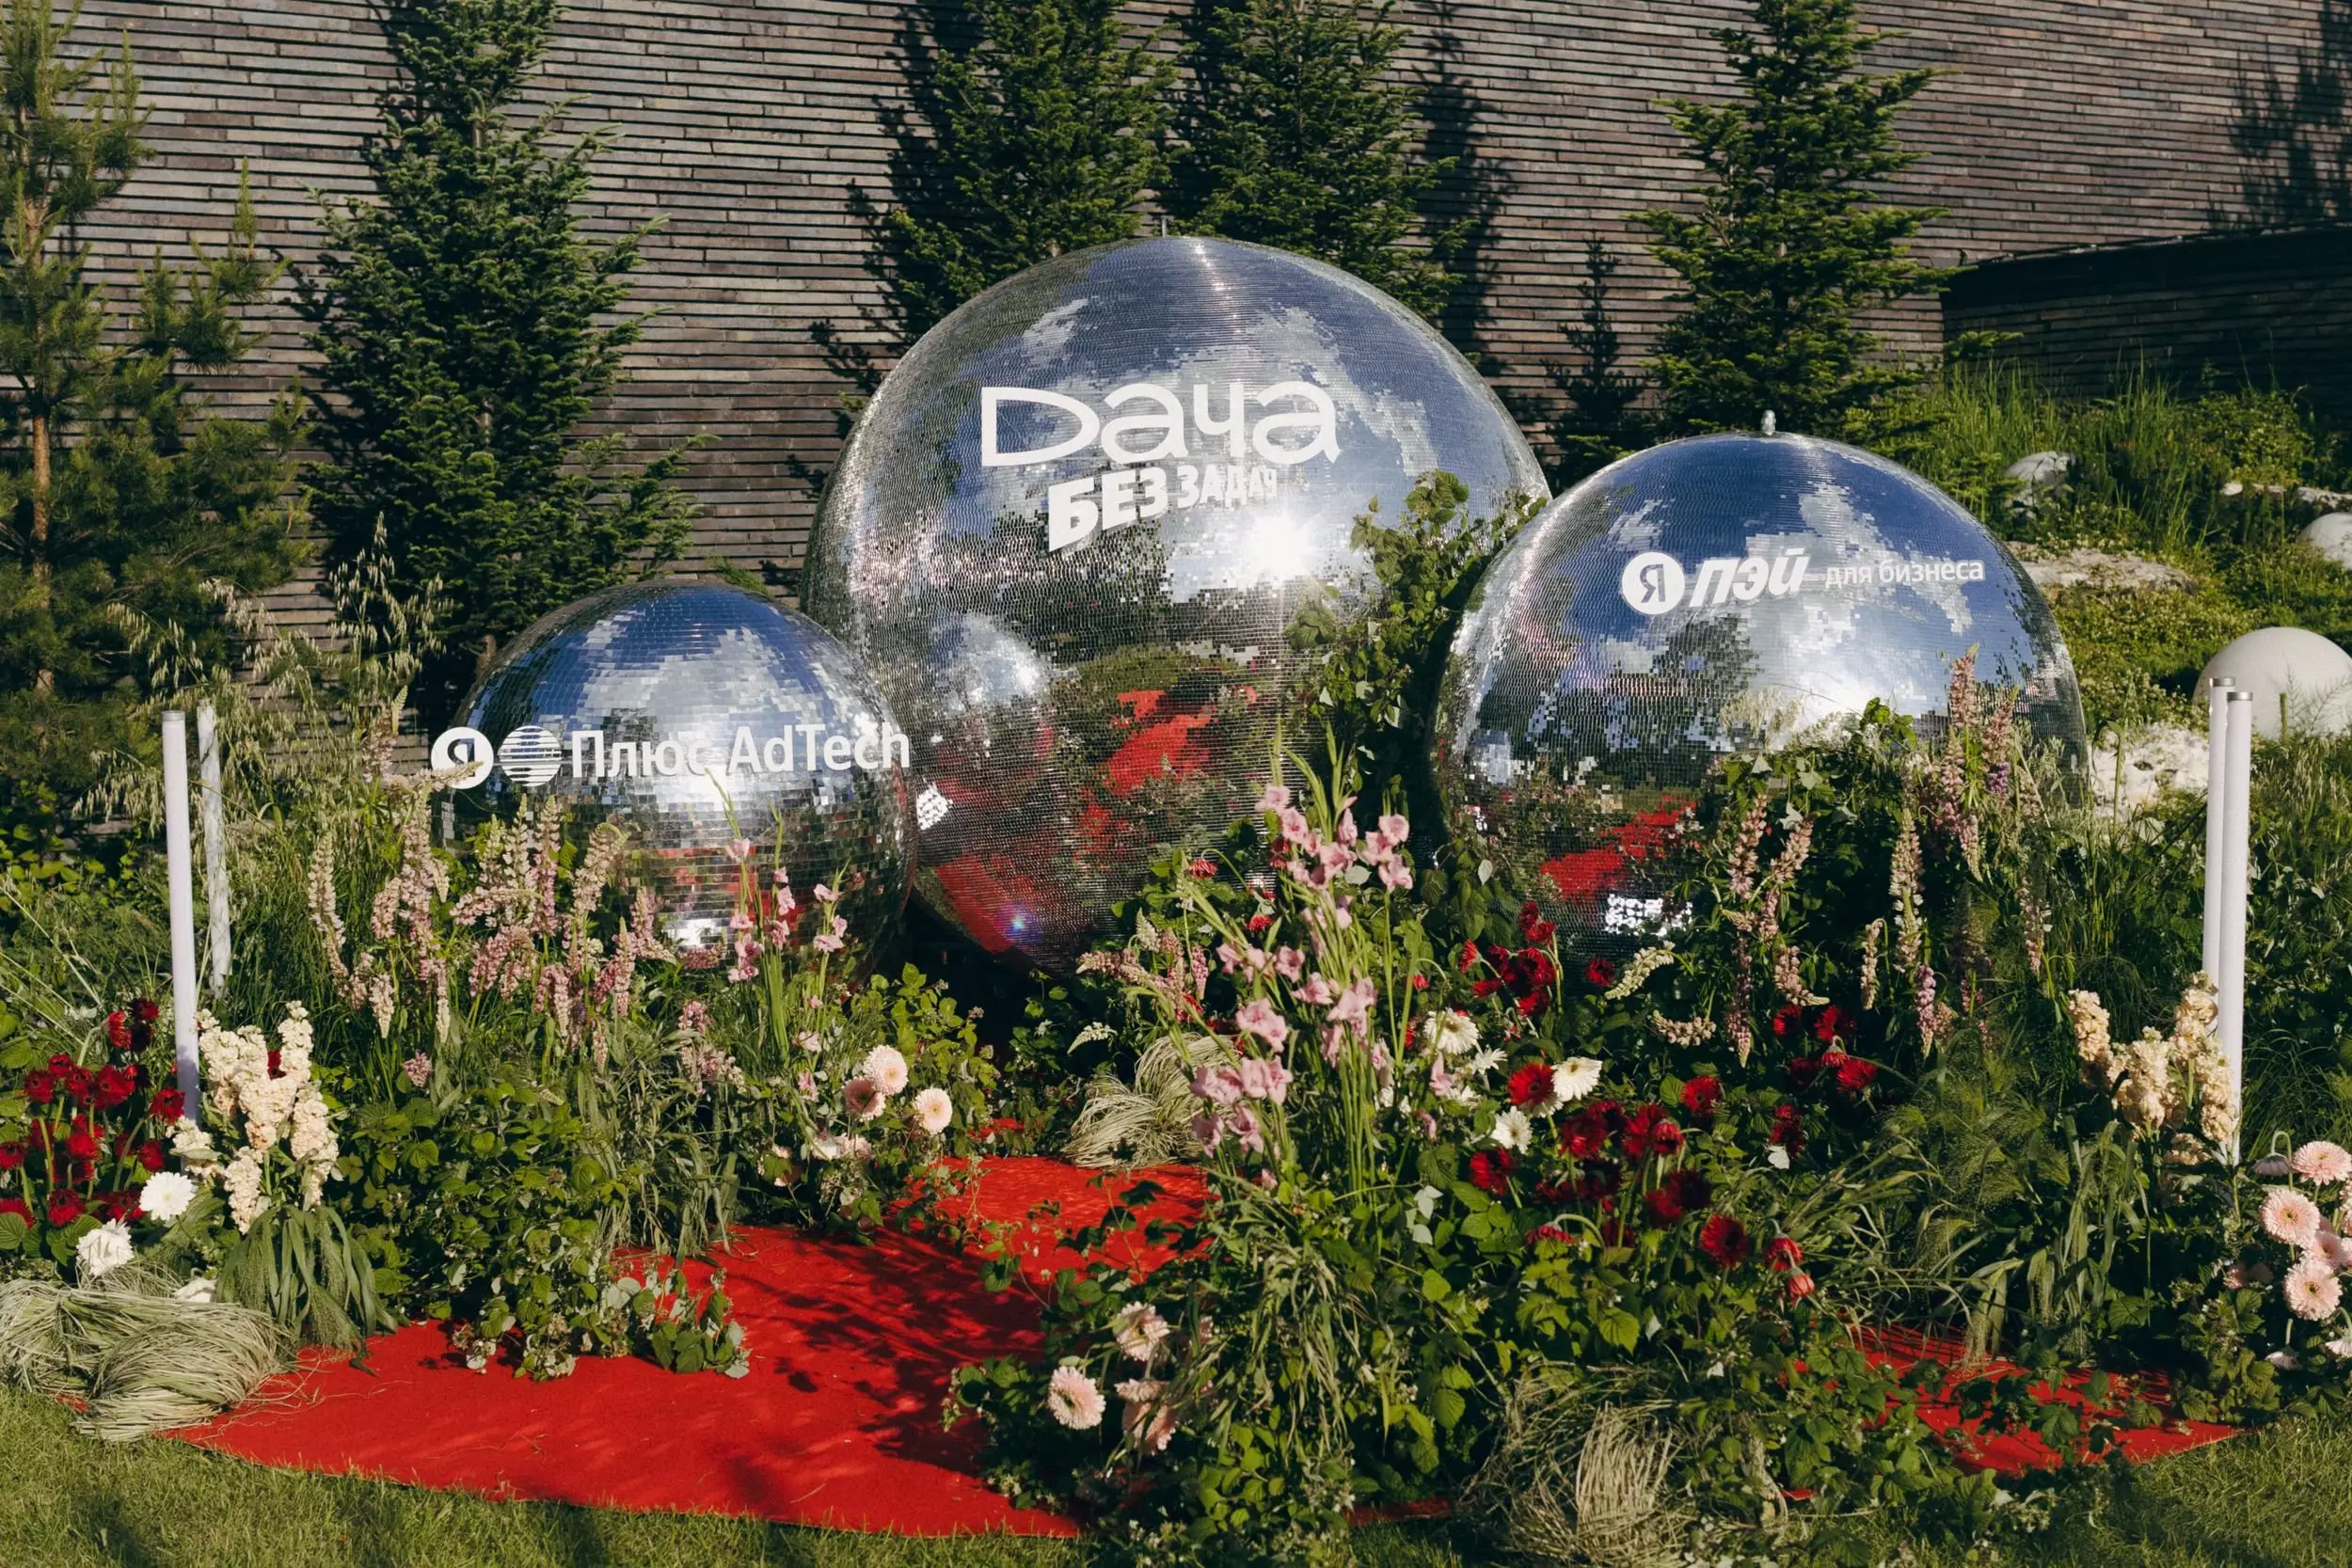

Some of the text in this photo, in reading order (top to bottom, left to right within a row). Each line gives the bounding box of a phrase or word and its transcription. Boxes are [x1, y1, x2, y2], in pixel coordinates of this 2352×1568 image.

[1049, 464, 1277, 552] БЕЗ ЗАДАЧ
[1825, 565, 1872, 590] для
[1879, 559, 1984, 584] бизнеса
[571, 730, 712, 778] Плюс
[728, 722, 912, 774] AdTech
